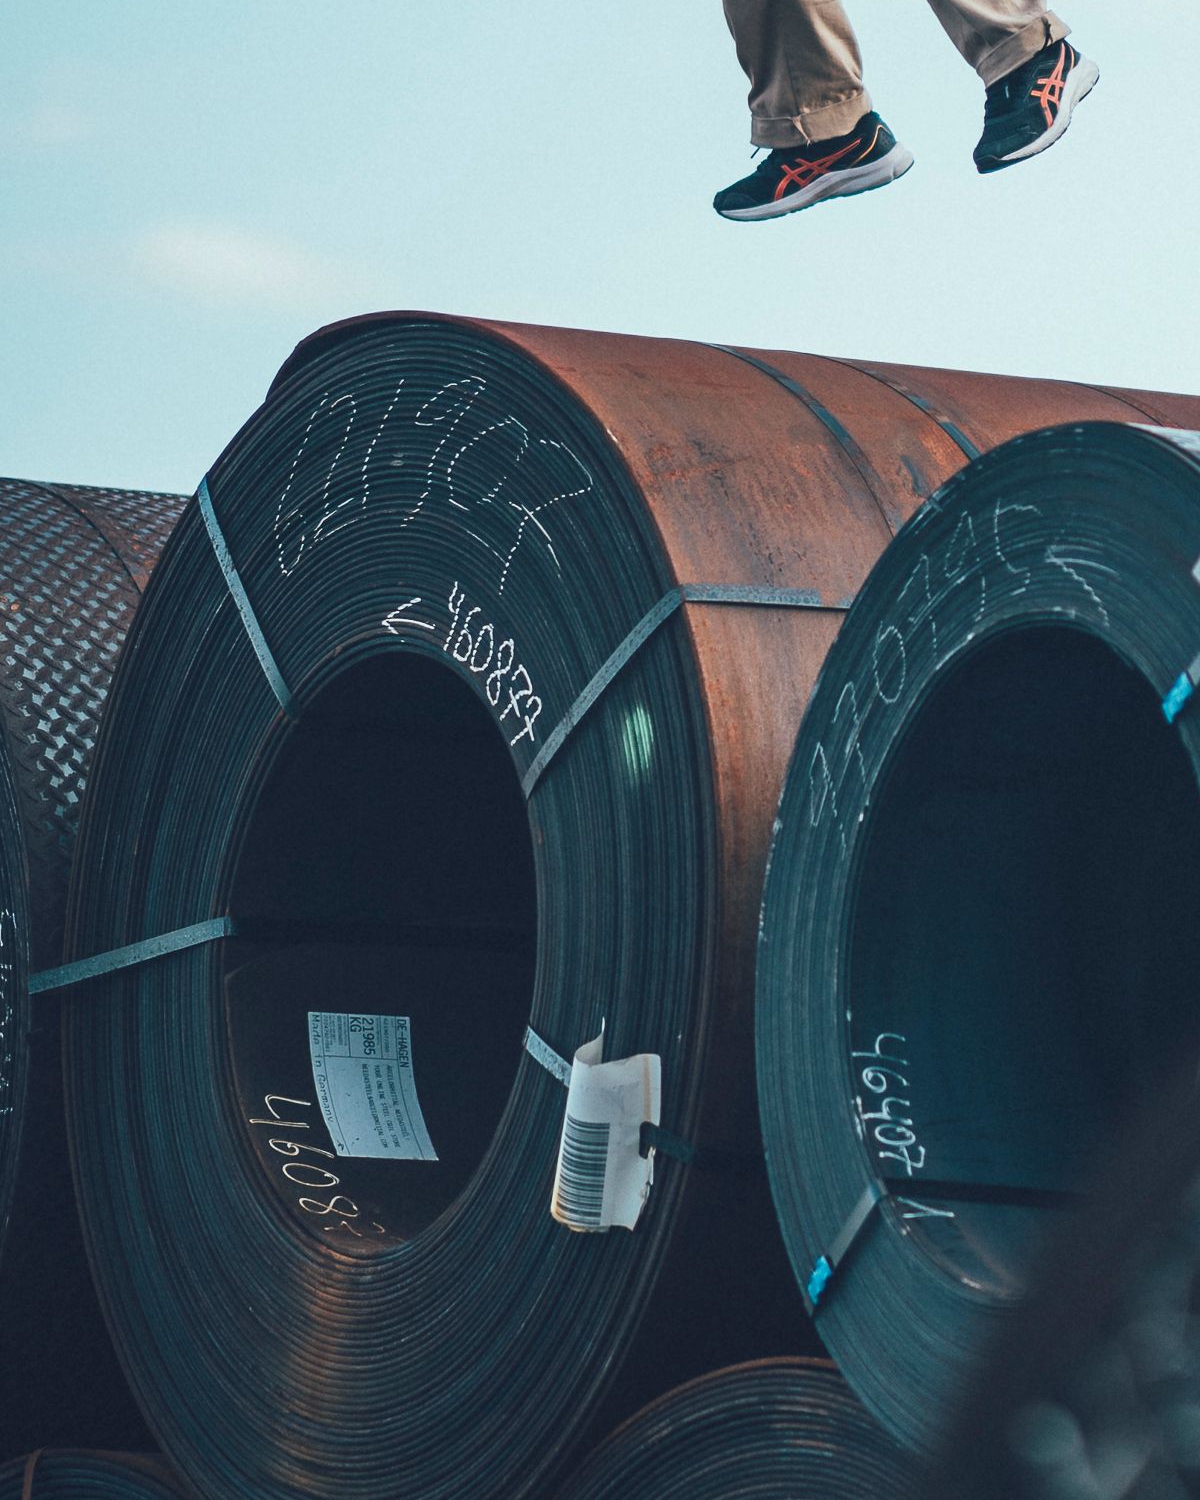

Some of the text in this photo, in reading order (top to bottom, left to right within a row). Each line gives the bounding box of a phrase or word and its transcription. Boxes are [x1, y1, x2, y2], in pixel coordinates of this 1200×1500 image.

[443, 580, 542, 747] 460877
[311, 1014, 323, 1045] Made
[350, 1016, 362, 1033] KG
[362, 1017, 375, 1056] 21985
[397, 1018, 409, 1068] DE-HAGEN
